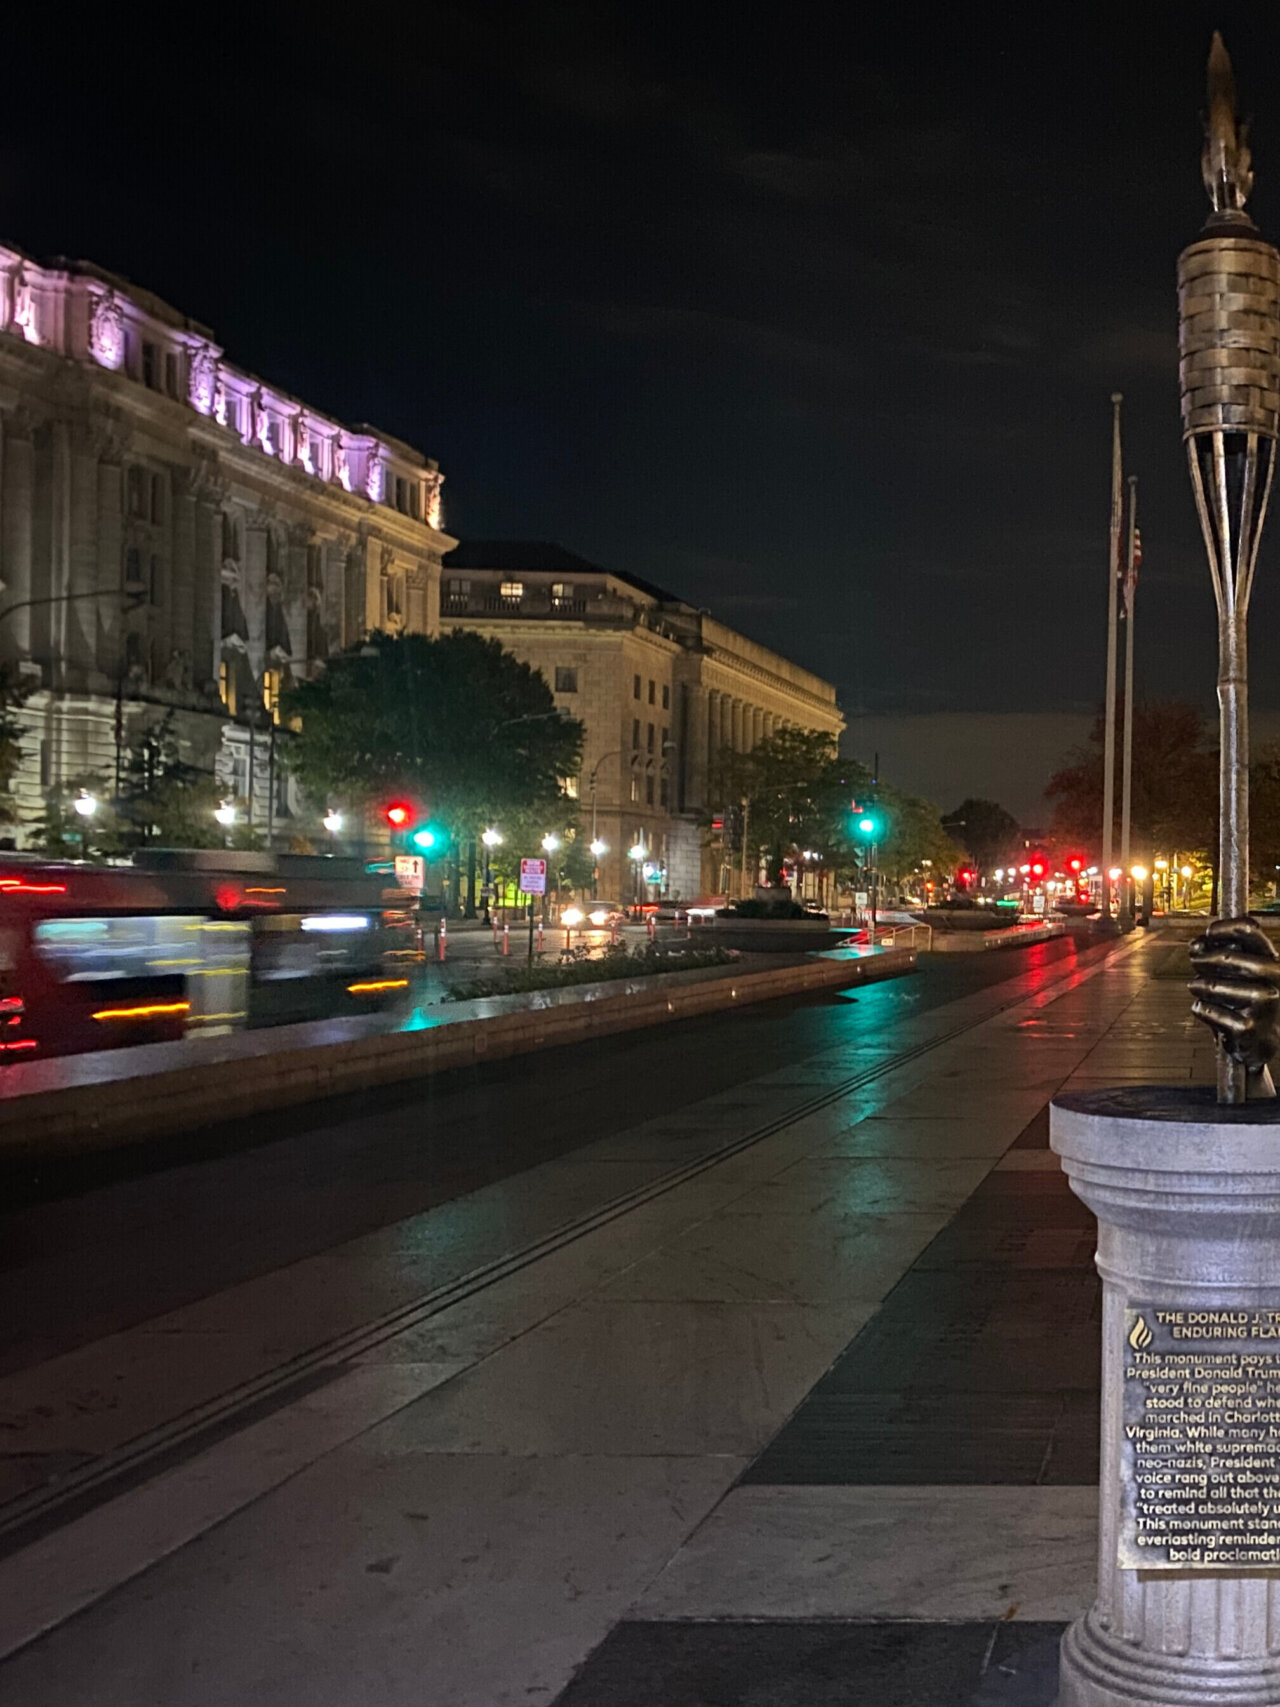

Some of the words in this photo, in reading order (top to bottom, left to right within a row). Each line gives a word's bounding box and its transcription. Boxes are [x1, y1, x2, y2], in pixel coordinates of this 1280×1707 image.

[1156, 1312, 1185, 1324] THE
[1188, 1312, 1248, 1324] DONALD
[1173, 1326, 1247, 1339] ENDURING
[1134, 1352, 1162, 1364] This
[1165, 1353, 1237, 1365] monument
[1241, 1354, 1272, 1366] pays
[1127, 1367, 1190, 1379] President
[1194, 1366, 1243, 1379] Donald
[1183, 1381, 1208, 1393] fine
[1145, 1396, 1184, 1408] stood
[1187, 1397, 1202, 1408] to
[1205, 1396, 1252, 1408] defend
[1145, 1411, 1205, 1423] marched
[1208, 1411, 1221, 1423] in
[1186, 1426, 1225, 1438] While
[1228, 1428, 1266, 1441] many
[1136, 1441, 1171, 1453] them
[1174, 1441, 1213, 1453] white
[1137, 1456, 1207, 1470] neo-nazis,
[1210, 1456, 1275, 1468] President
[1135, 1472, 1172, 1484] voice
[1175, 1474, 1207, 1487] rang
[1211, 1472, 1234, 1483] out
[1237, 1471, 1280, 1483] above
[1140, 1487, 1155, 1499] to
[1158, 1486, 1207, 1499] remind
[1210, 1486, 1227, 1498] all
[1230, 1486, 1259, 1498] that
[1198, 1501, 1270, 1517] absolutely
[1137, 1517, 1166, 1530] This
[1169, 1518, 1244, 1530] monument
[1137, 1533, 1216, 1549] everlasting
[1169, 1548, 1200, 1561] bold
